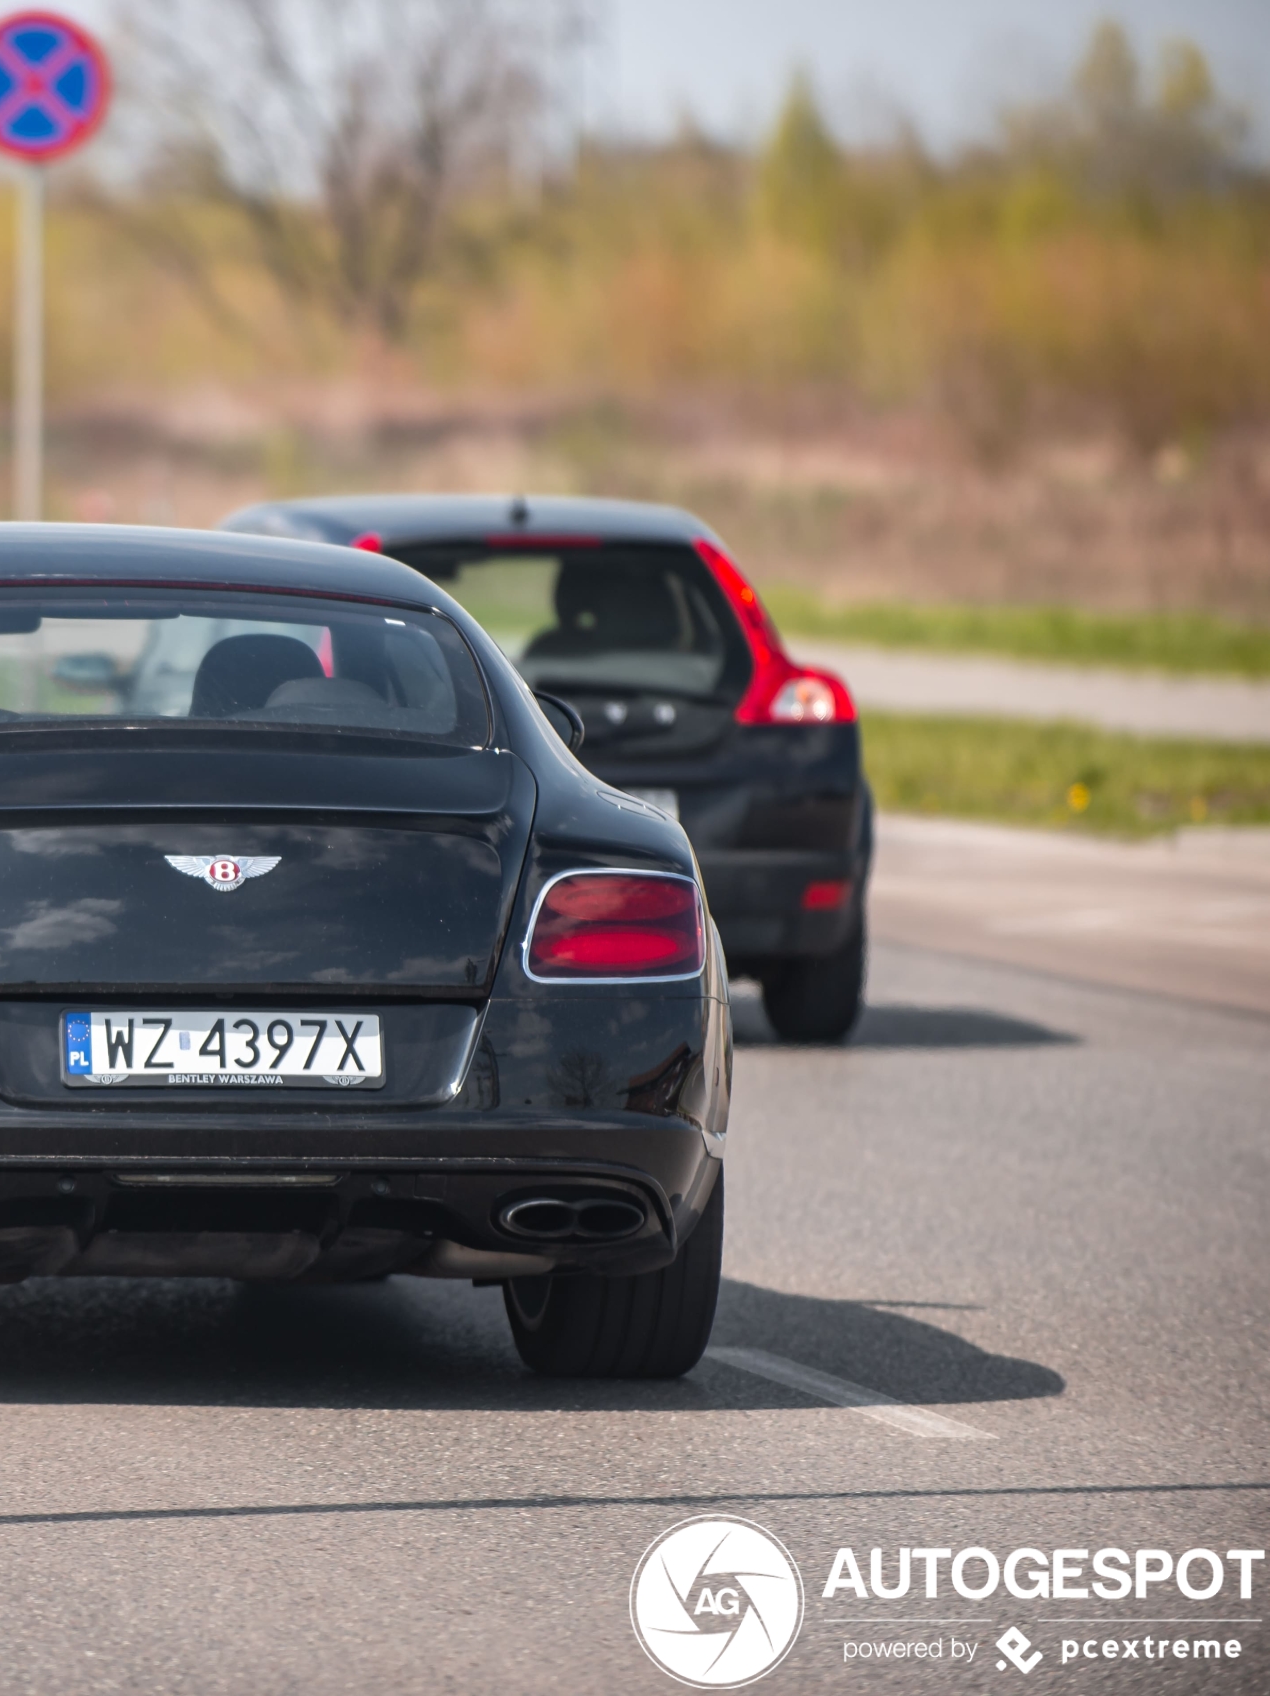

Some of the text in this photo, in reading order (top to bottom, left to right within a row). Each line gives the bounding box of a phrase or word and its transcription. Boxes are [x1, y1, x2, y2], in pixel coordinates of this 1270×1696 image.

[214, 861, 236, 882] B
[104, 1018, 365, 1071] WZ 4397X
[70, 1051, 89, 1066] PL
[168, 1074, 284, 1085] BENTLEY WARSZAWA
